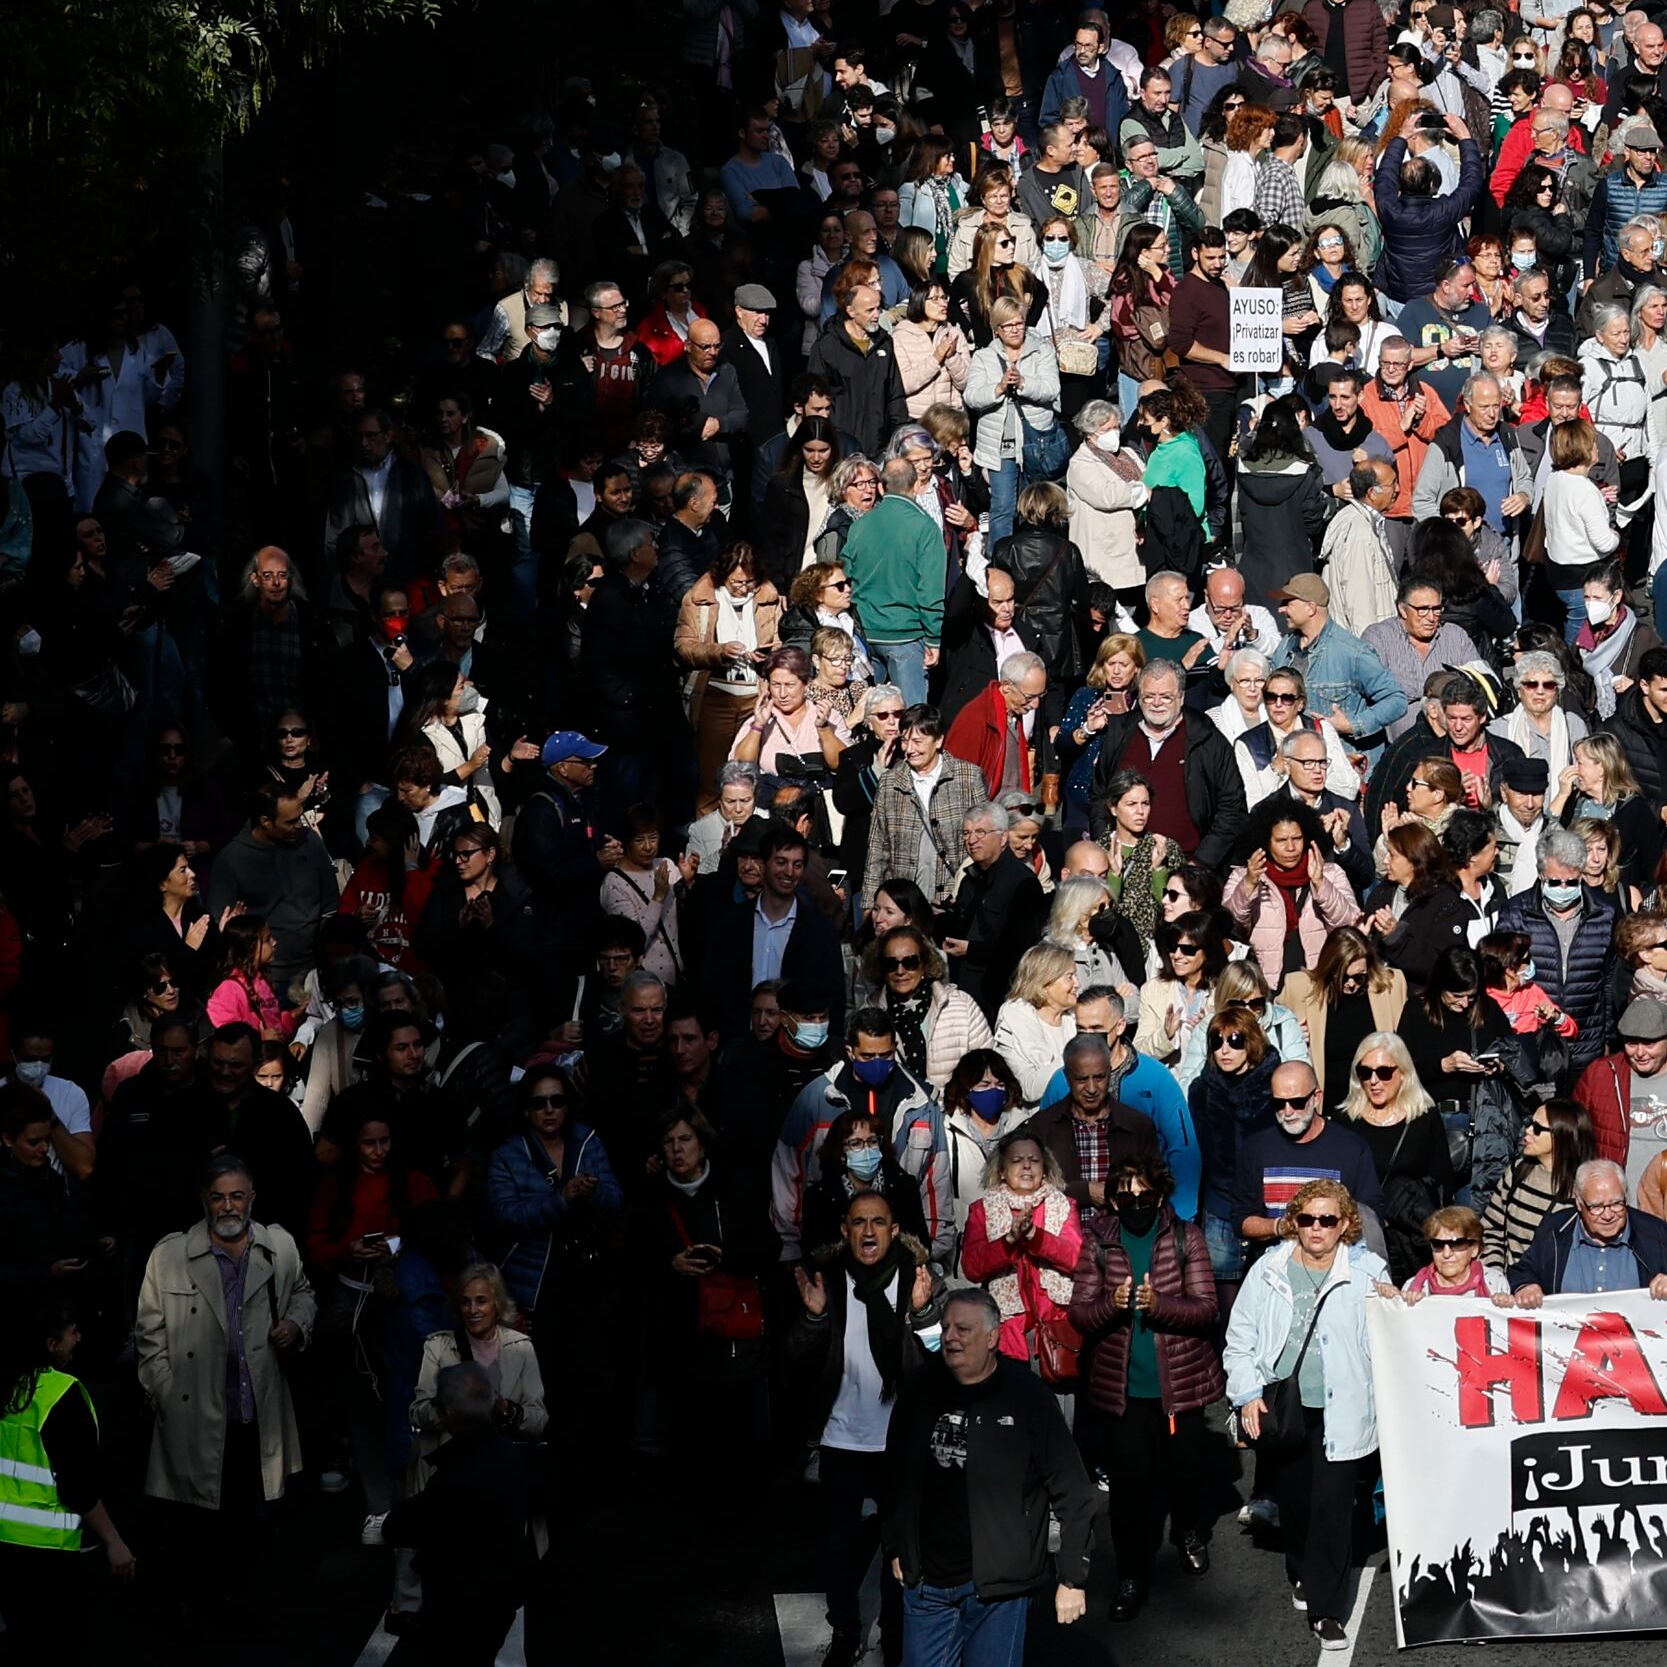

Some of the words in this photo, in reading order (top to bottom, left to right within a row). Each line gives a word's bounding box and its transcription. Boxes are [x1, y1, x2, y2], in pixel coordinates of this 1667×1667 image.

[1232, 298, 1280, 316] AYUSO:
[1232, 322, 1280, 343] ¡Privatizar
[1232, 351, 1245, 364] es
[1247, 348, 1280, 364] robar!
